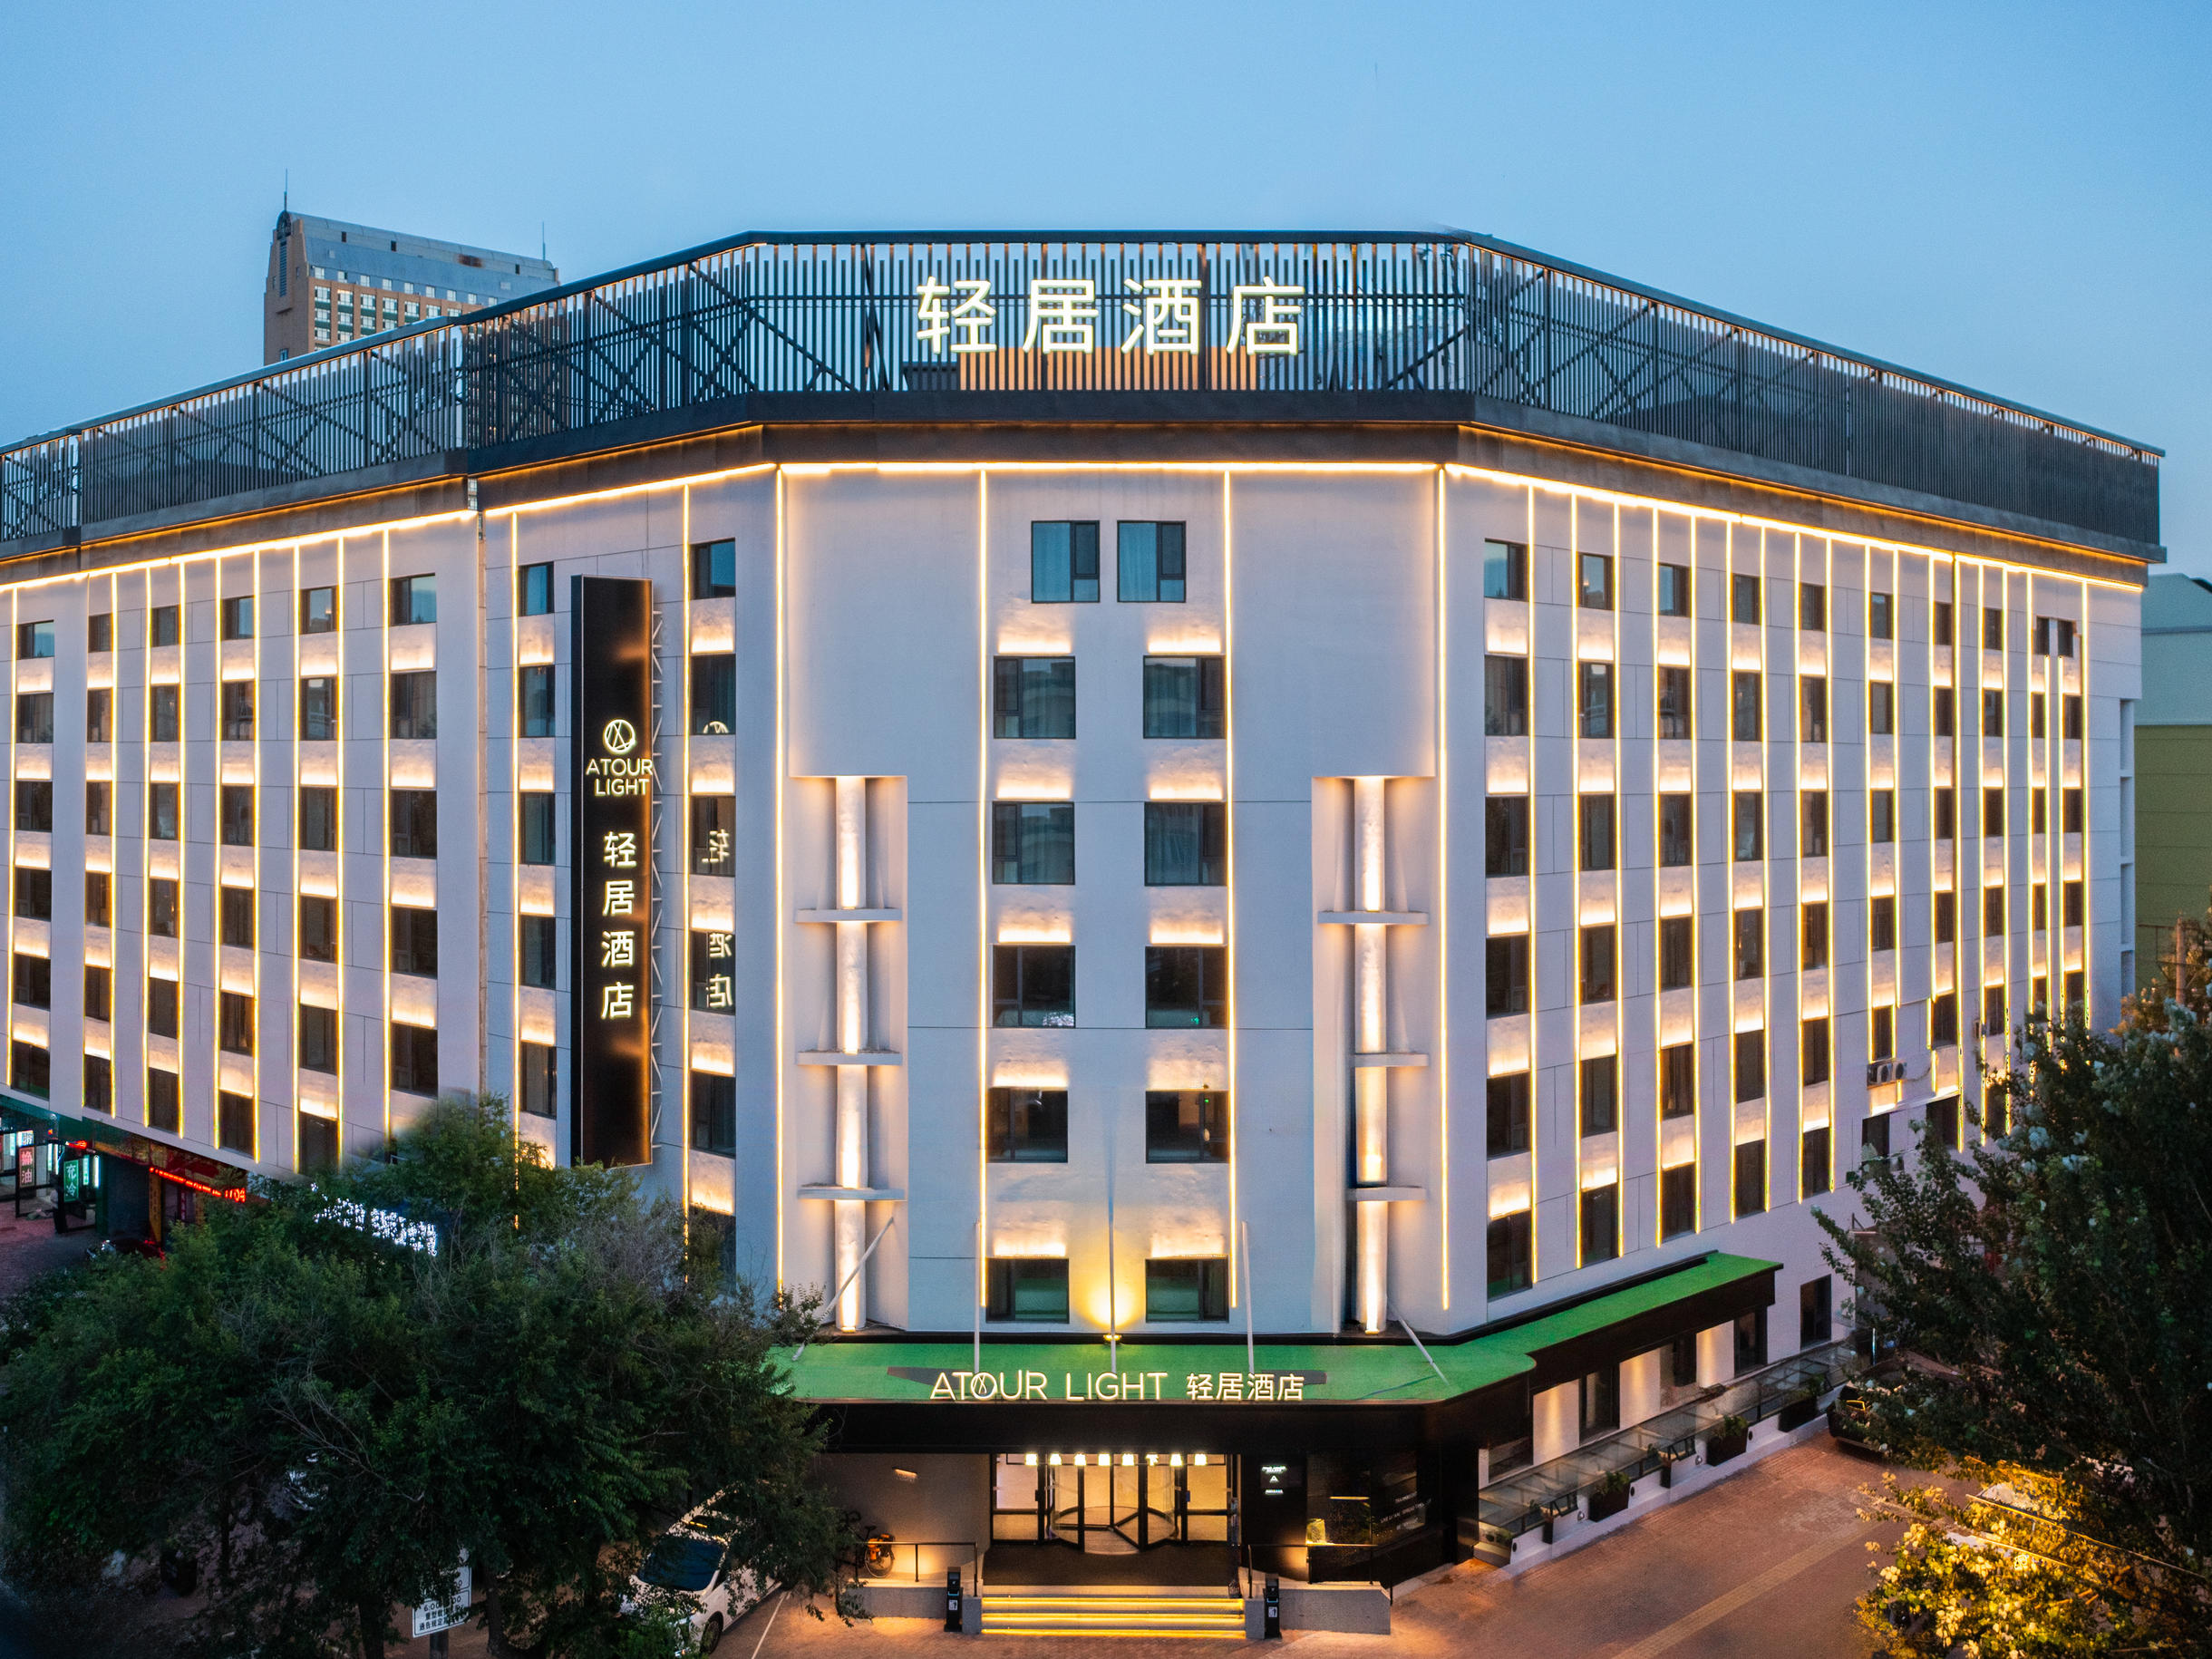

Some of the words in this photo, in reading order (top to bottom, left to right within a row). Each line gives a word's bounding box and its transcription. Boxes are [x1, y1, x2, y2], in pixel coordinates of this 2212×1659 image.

[916, 276, 1305, 355] 轻居酒店
[586, 758, 653, 776] ATOUR
[595, 778, 649, 796] LIGHT
[601, 831, 637, 1020] 轻居酒店
[930, 1370, 1048, 1401] ATOUR
[1066, 1372, 1169, 1402] LIGHT
[1186, 1372, 1305, 1402] 轻居酒店
